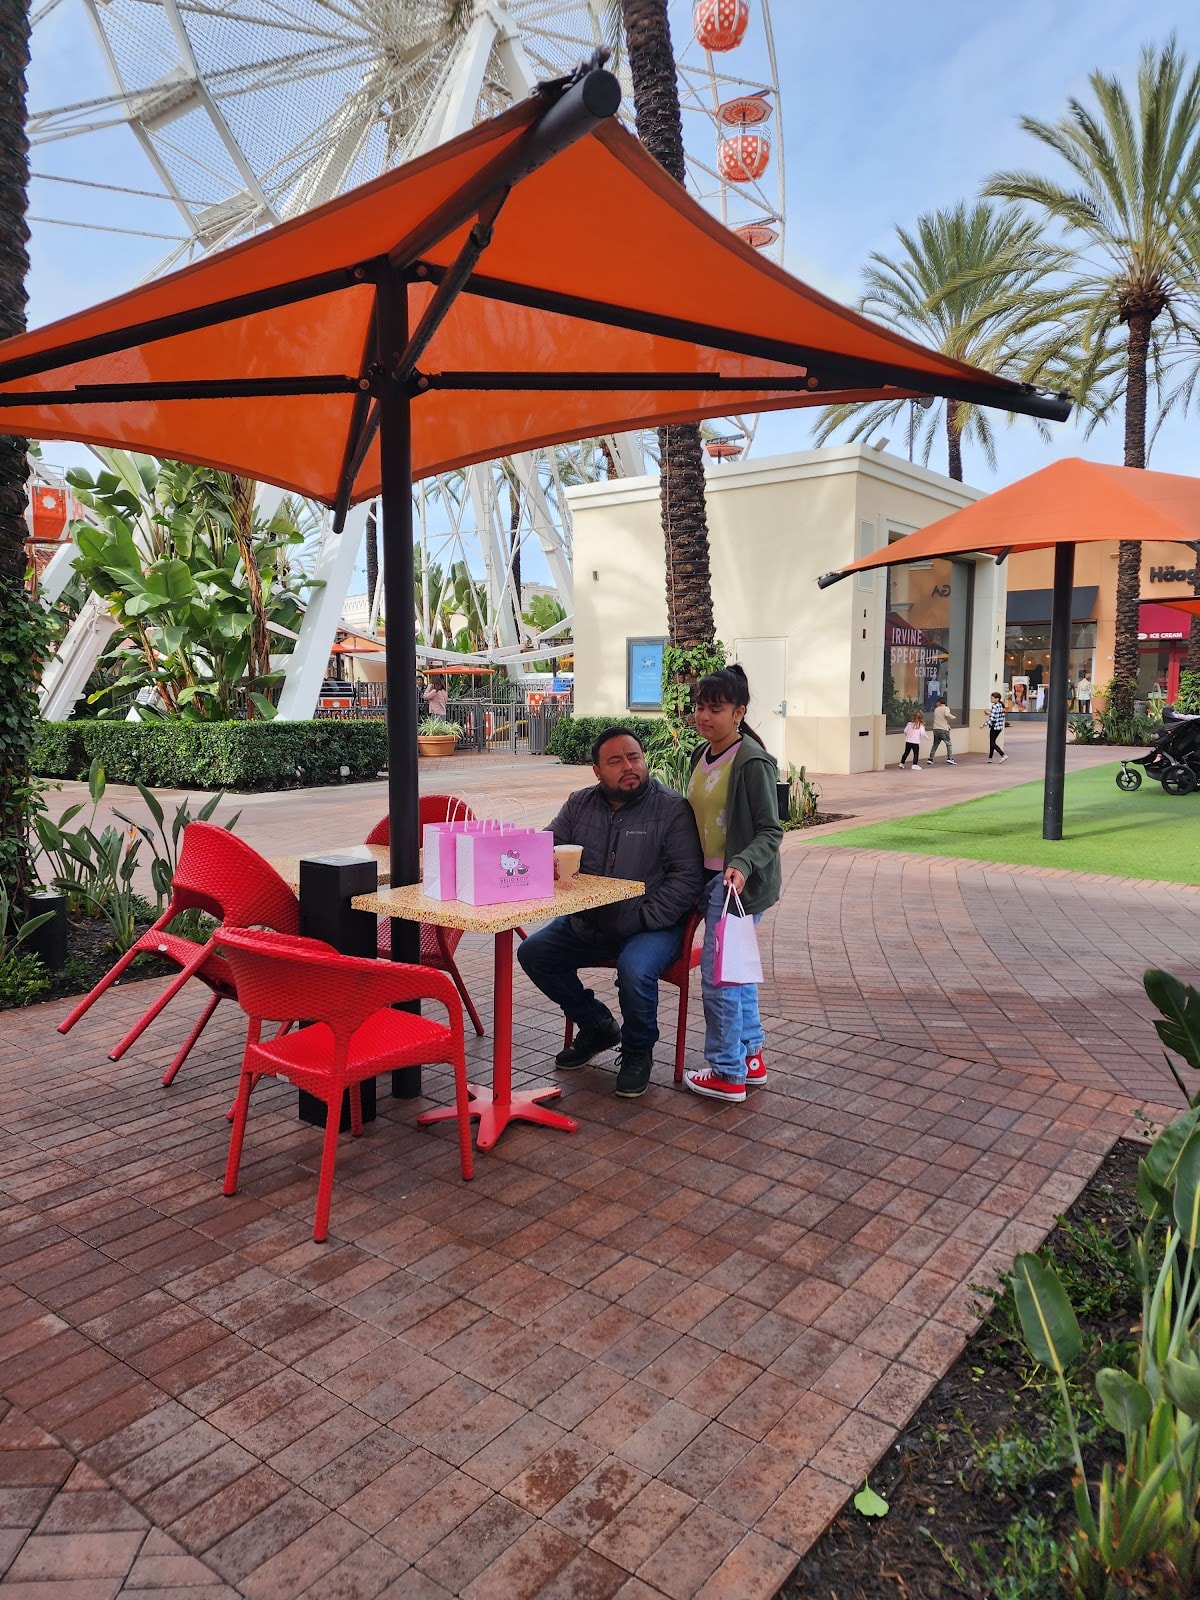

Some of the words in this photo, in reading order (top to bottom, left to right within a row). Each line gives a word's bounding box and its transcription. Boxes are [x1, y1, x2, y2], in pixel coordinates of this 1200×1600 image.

[892, 628, 922, 645] IRVINE
[891, 648, 939, 665] SPECTRUM
[914, 667, 938, 678] CENTER
